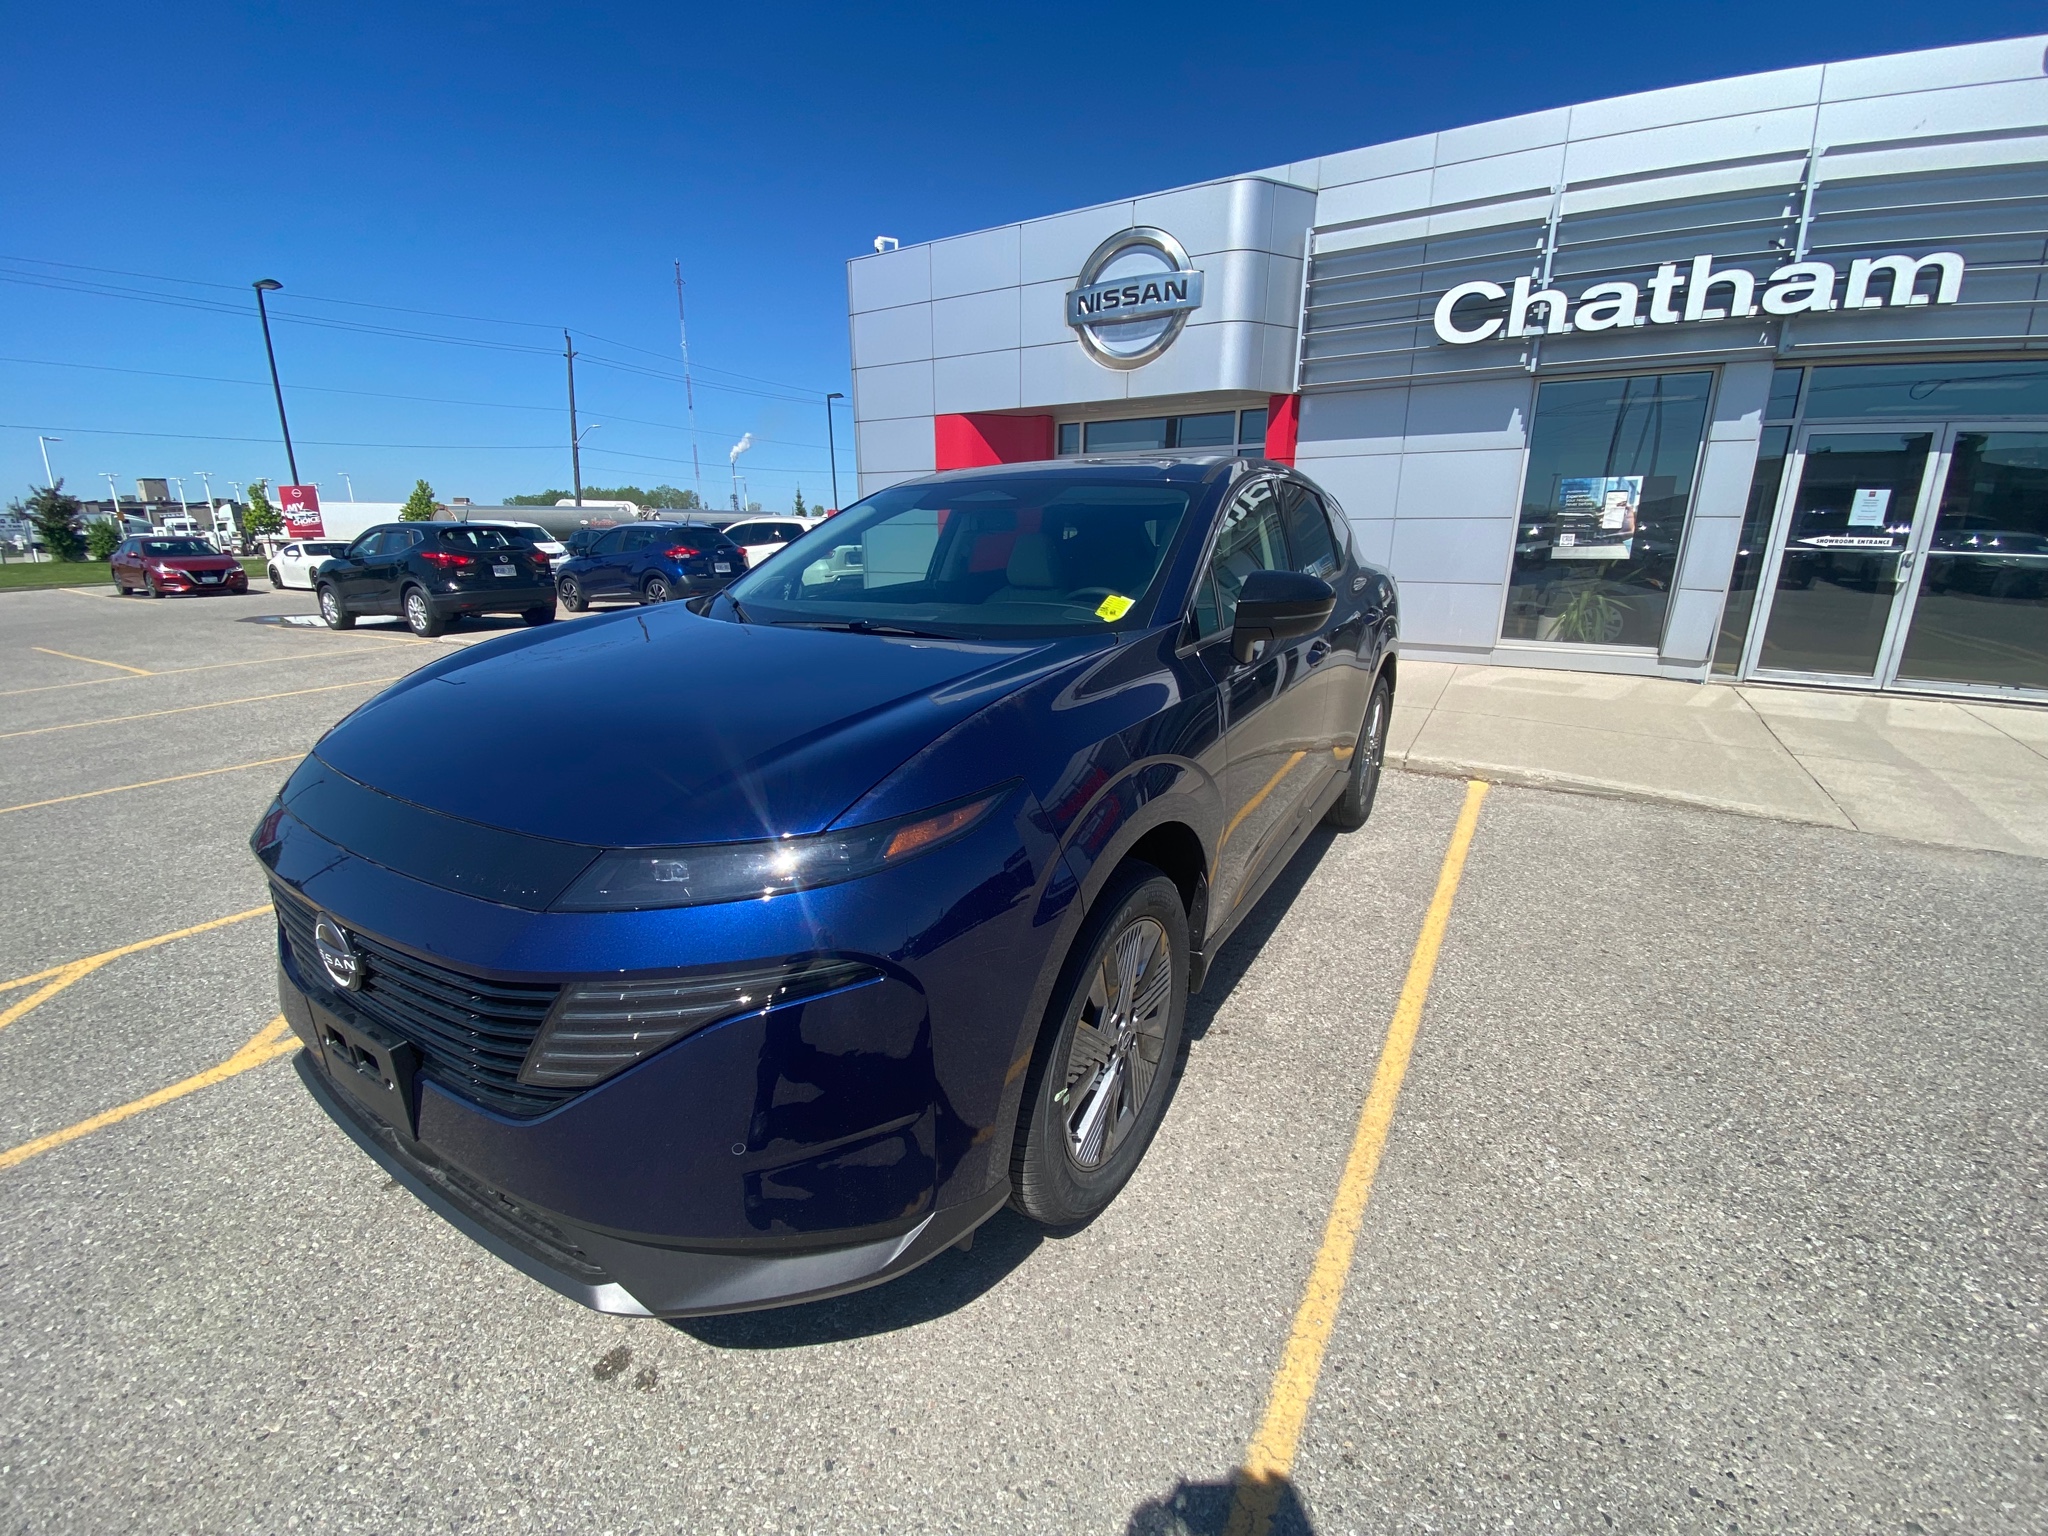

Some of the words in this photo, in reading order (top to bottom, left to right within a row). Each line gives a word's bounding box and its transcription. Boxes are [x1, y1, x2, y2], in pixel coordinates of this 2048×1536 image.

[1077, 279, 1188, 316] NISSAN
[1433, 251, 1966, 346] Chatham
[287, 502, 305, 511] MY
